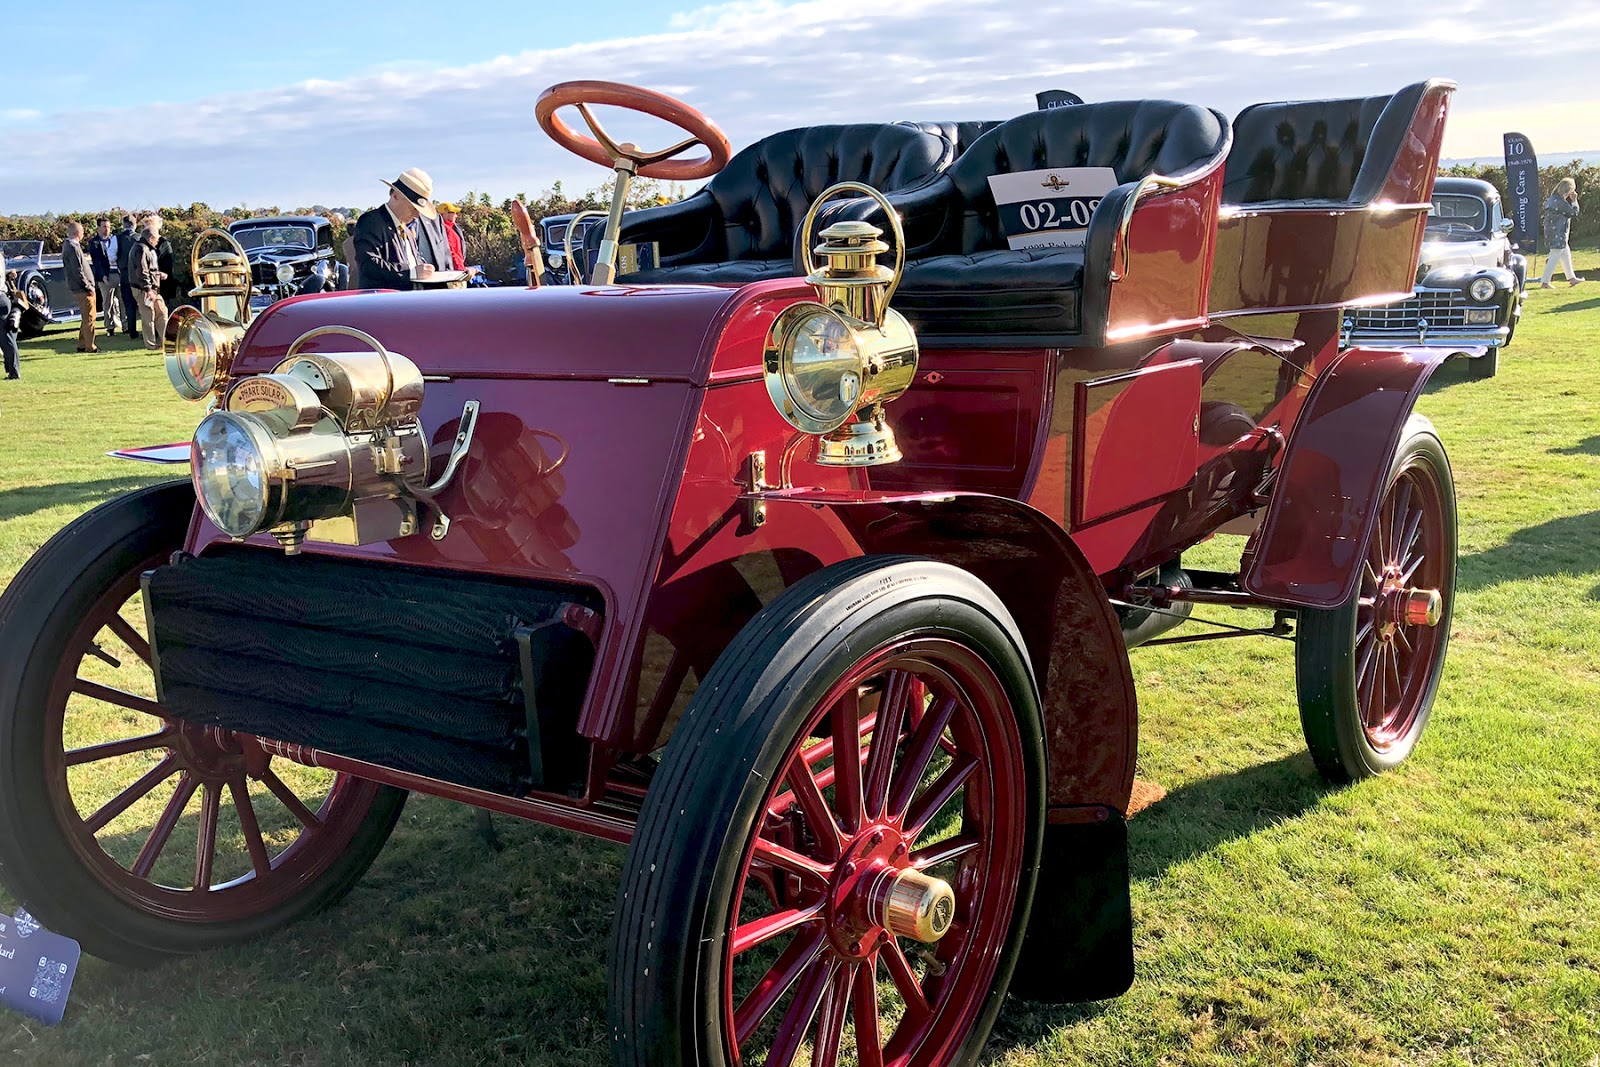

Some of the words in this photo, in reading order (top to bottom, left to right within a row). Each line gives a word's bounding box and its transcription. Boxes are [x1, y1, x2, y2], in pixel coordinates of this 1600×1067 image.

[1508, 142, 1524, 156] 10
[1515, 170, 1526, 195] Cars
[240, 386, 260, 400] PHARE
[260, 385, 281, 401] SOLAR
